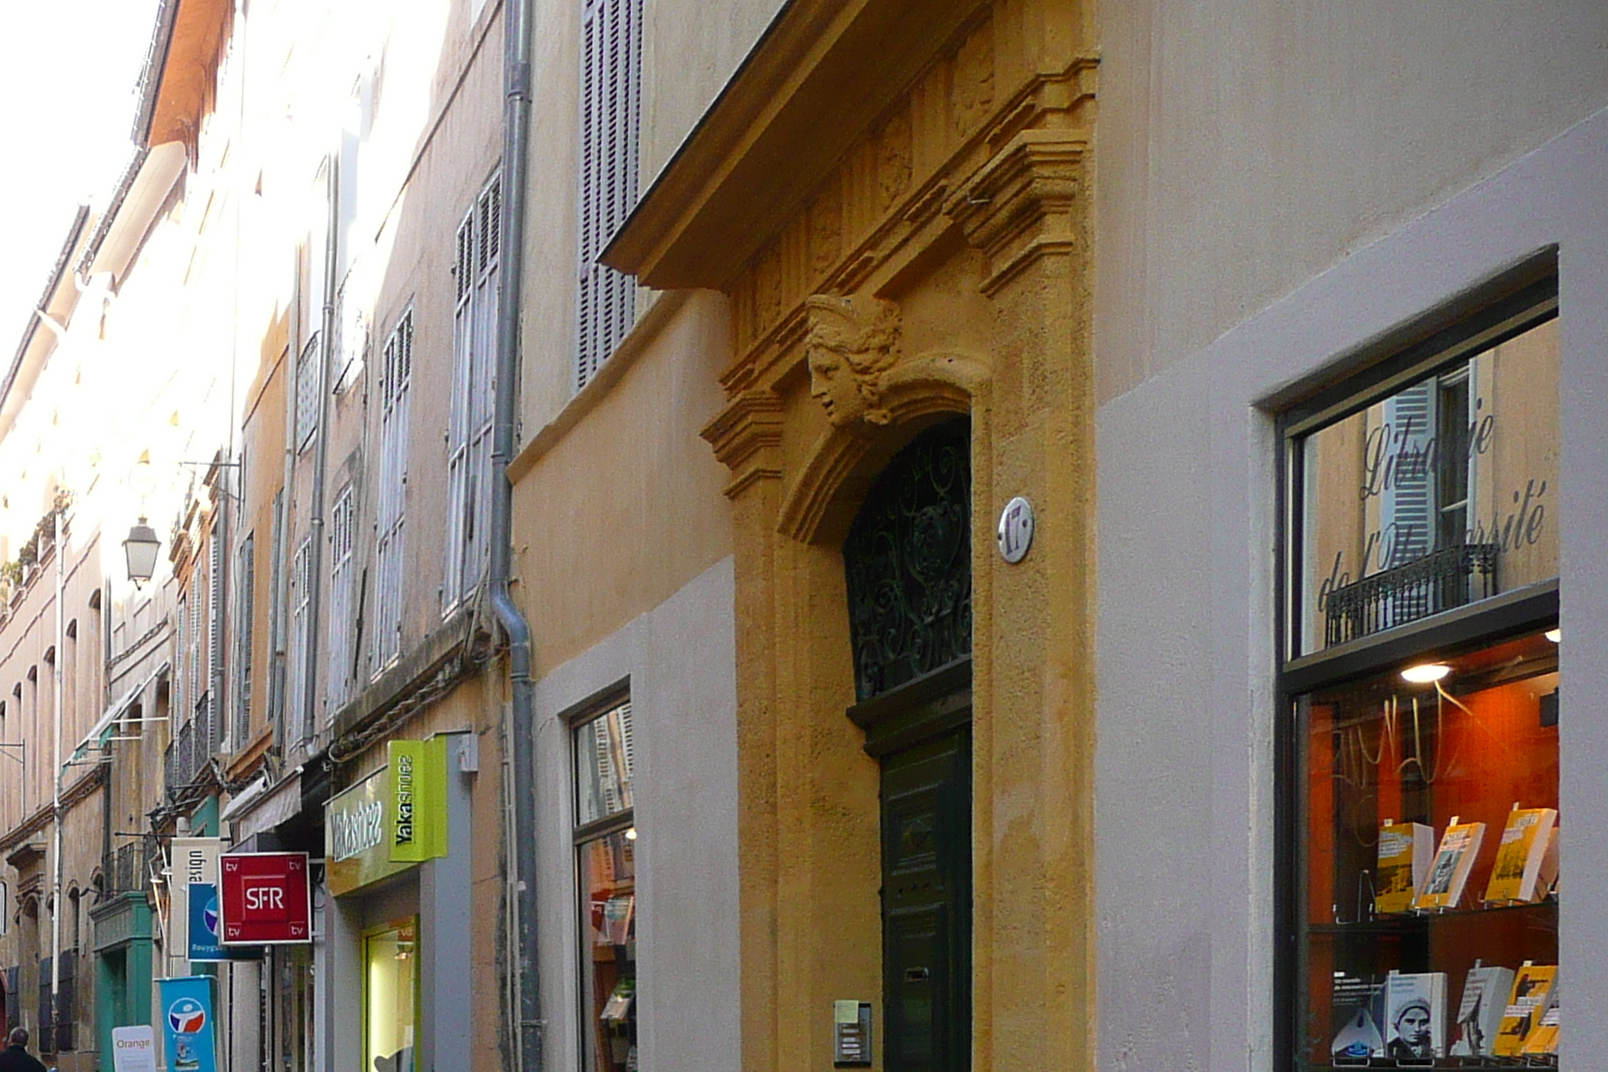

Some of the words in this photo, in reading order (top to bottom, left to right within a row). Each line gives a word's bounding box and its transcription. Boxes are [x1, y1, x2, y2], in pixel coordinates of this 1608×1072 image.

[396, 755, 412, 846] Yakashoes
[189, 850, 206, 882] esign
[226, 862, 238, 872] tv
[289, 861, 301, 871] tv
[246, 887, 284, 910] SFR
[228, 927, 240, 937] tv
[291, 925, 303, 935] tv
[116, 1039, 150, 1050] Orange
